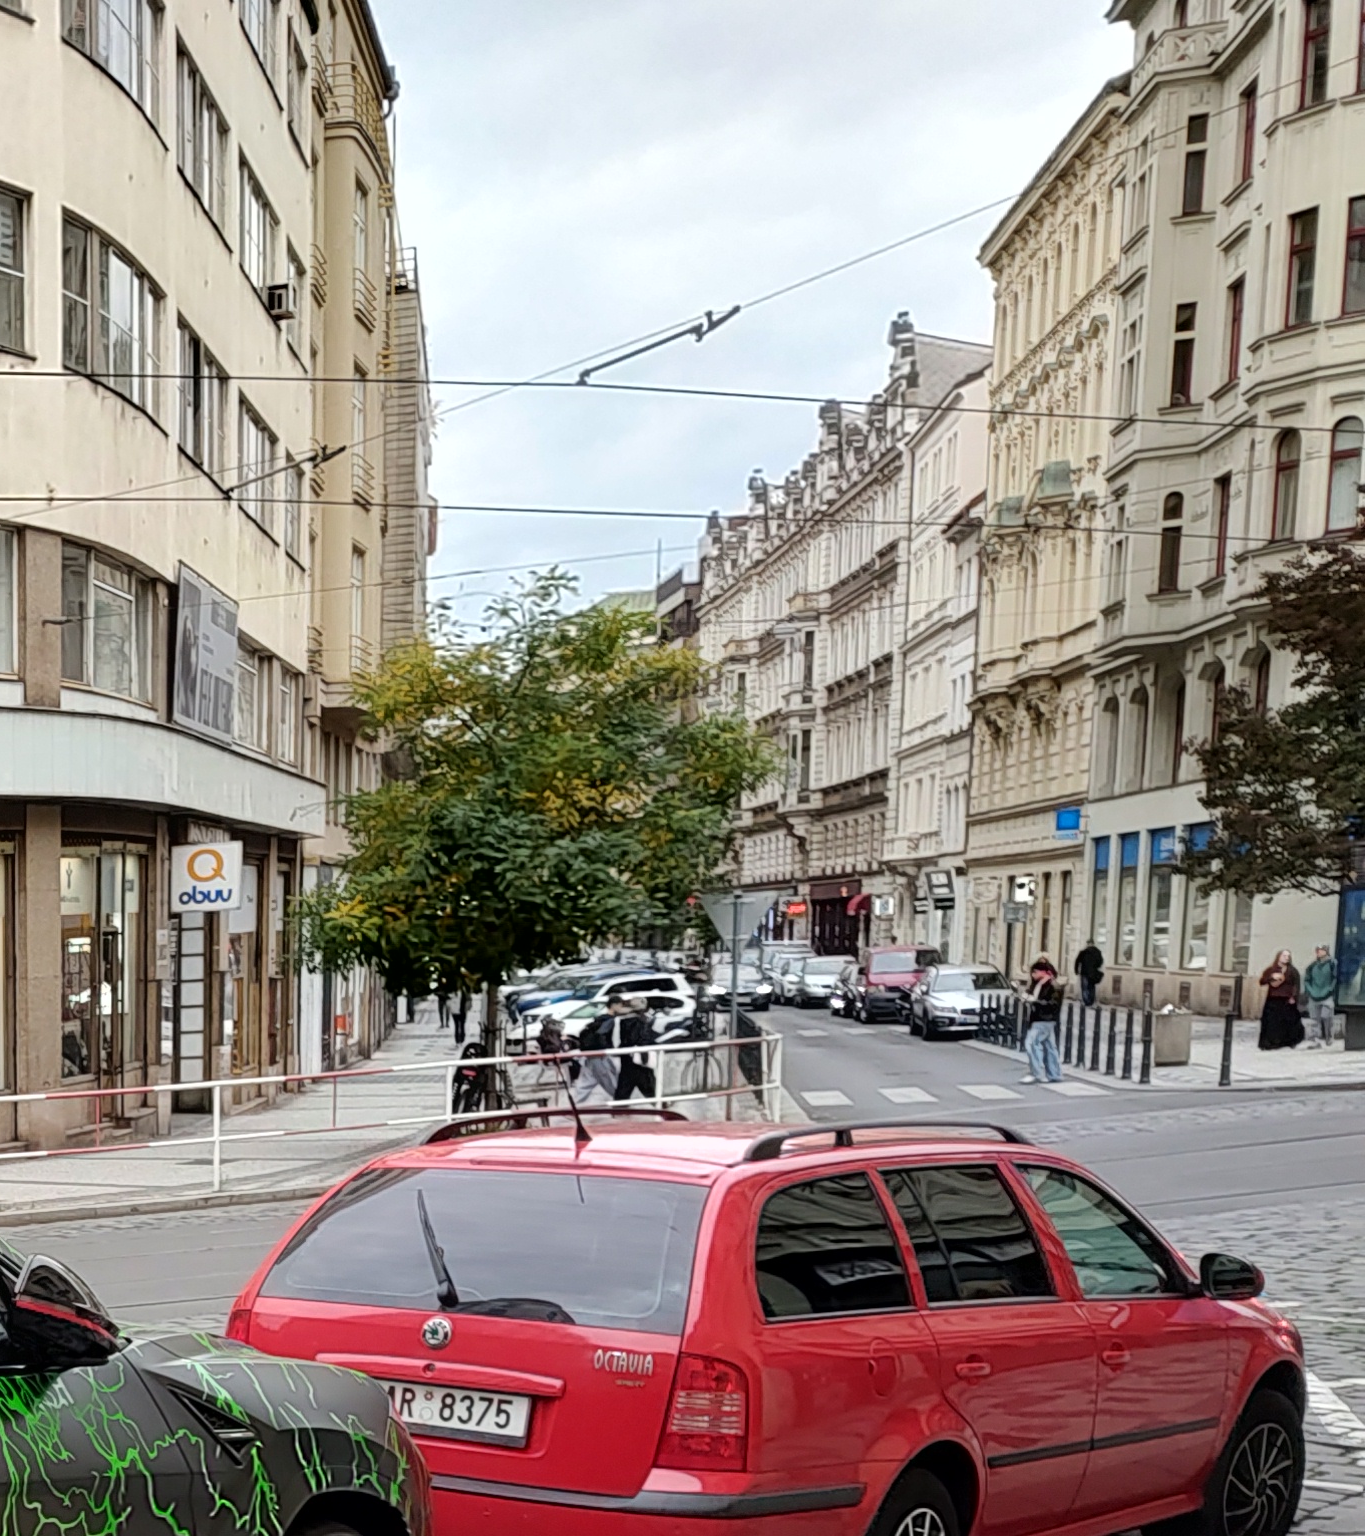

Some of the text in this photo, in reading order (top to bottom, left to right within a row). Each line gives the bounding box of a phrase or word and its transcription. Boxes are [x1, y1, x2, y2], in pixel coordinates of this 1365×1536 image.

[179, 885, 232, 905] obuv
[593, 1348, 654, 1377] OCTAVIA
[438, 1391, 515, 1430] 8375
